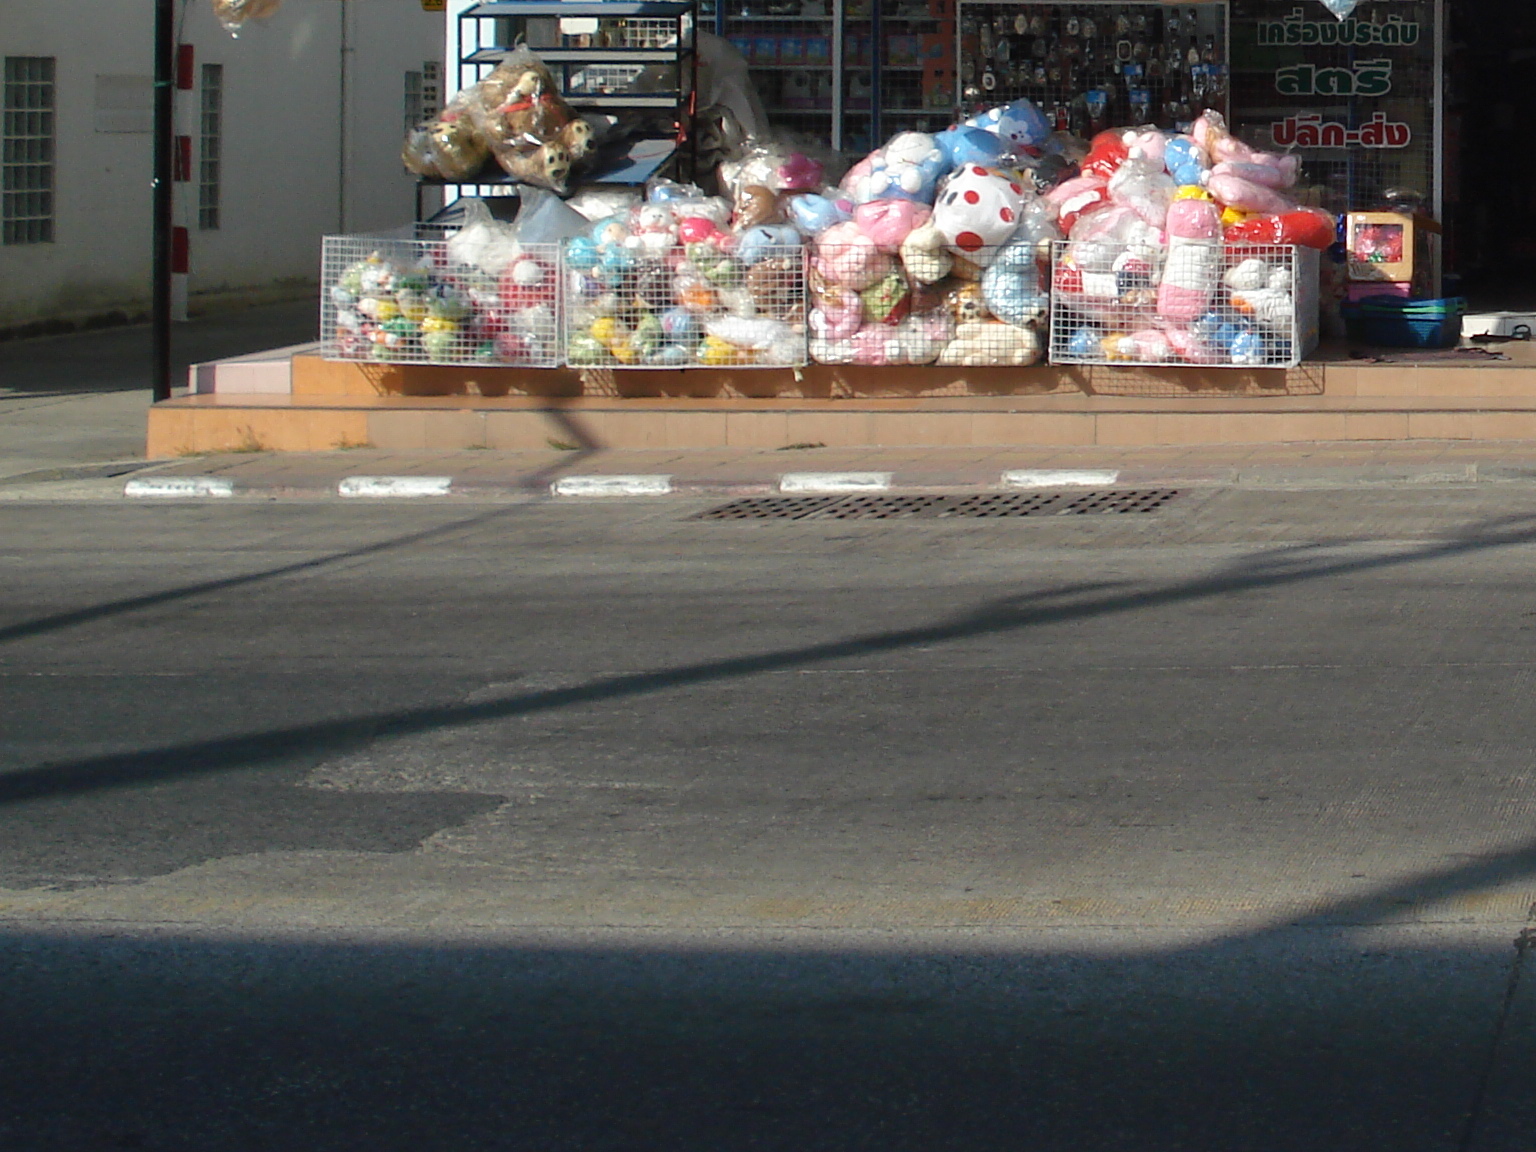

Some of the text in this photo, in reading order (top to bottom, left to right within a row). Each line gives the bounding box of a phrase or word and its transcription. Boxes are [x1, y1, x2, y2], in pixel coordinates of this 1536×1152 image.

[1258, 7, 1420, 46] เครื่องประดับ
[1275, 58, 1393, 97] สตรี
[1271, 111, 1412, 149] ปลีก-ส่ง
